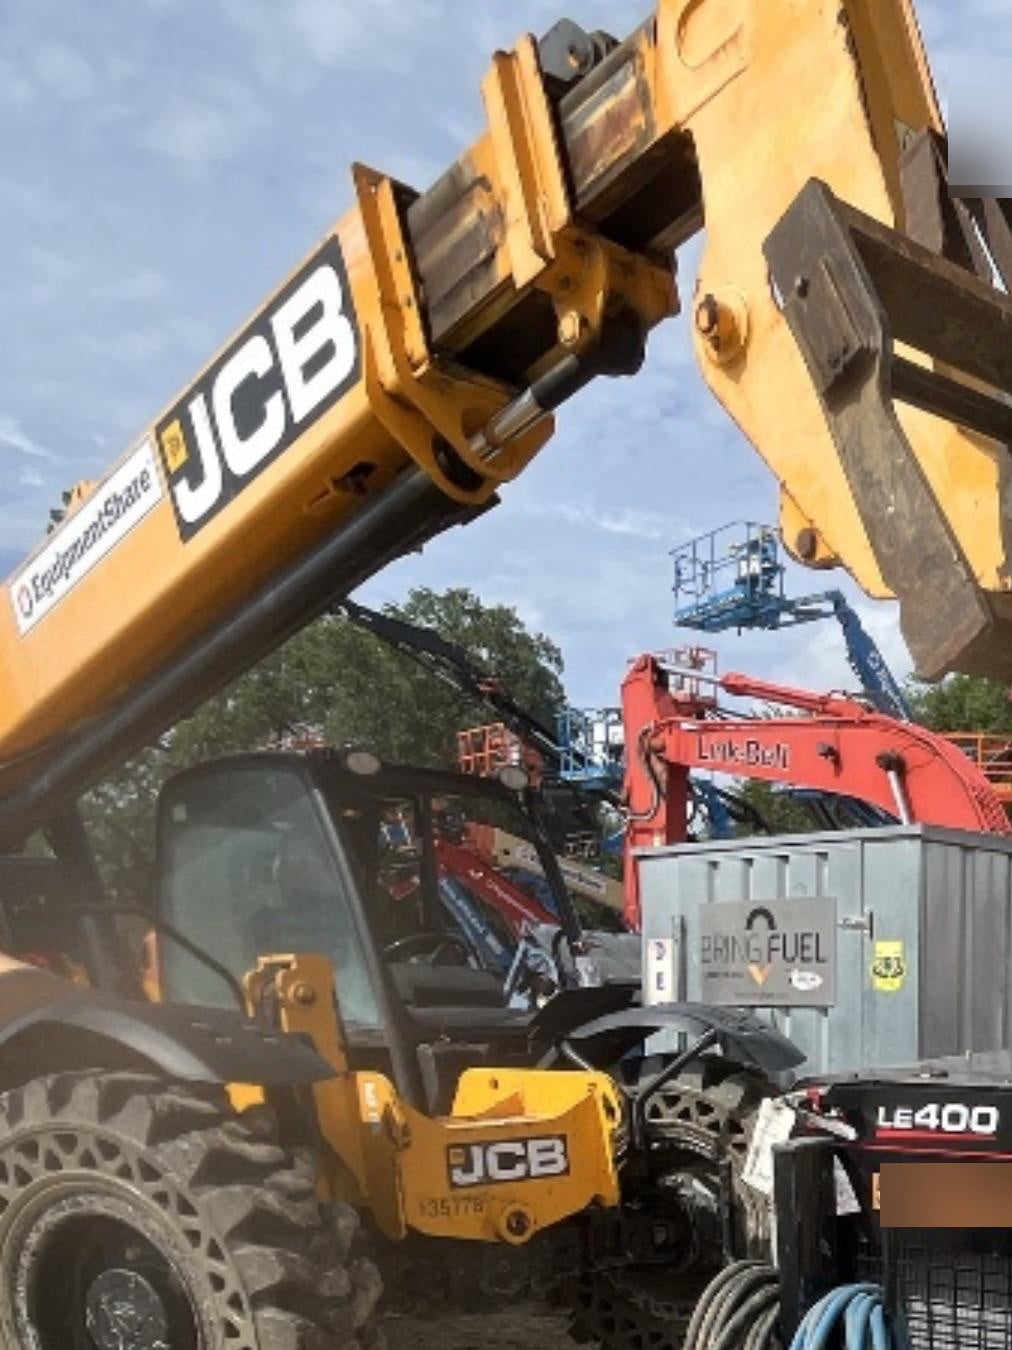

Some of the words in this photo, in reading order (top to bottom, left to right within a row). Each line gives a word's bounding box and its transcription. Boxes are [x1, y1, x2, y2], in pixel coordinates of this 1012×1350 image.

[174, 263, 357, 524] JCB
[31, 467, 151, 603] EquipmentShare
[697, 736, 789, 769] Link-Belt
[767, 932, 827, 963] FUEL
[878, 1103, 1000, 1134] LE400
[451, 1138, 567, 1186] JCB
